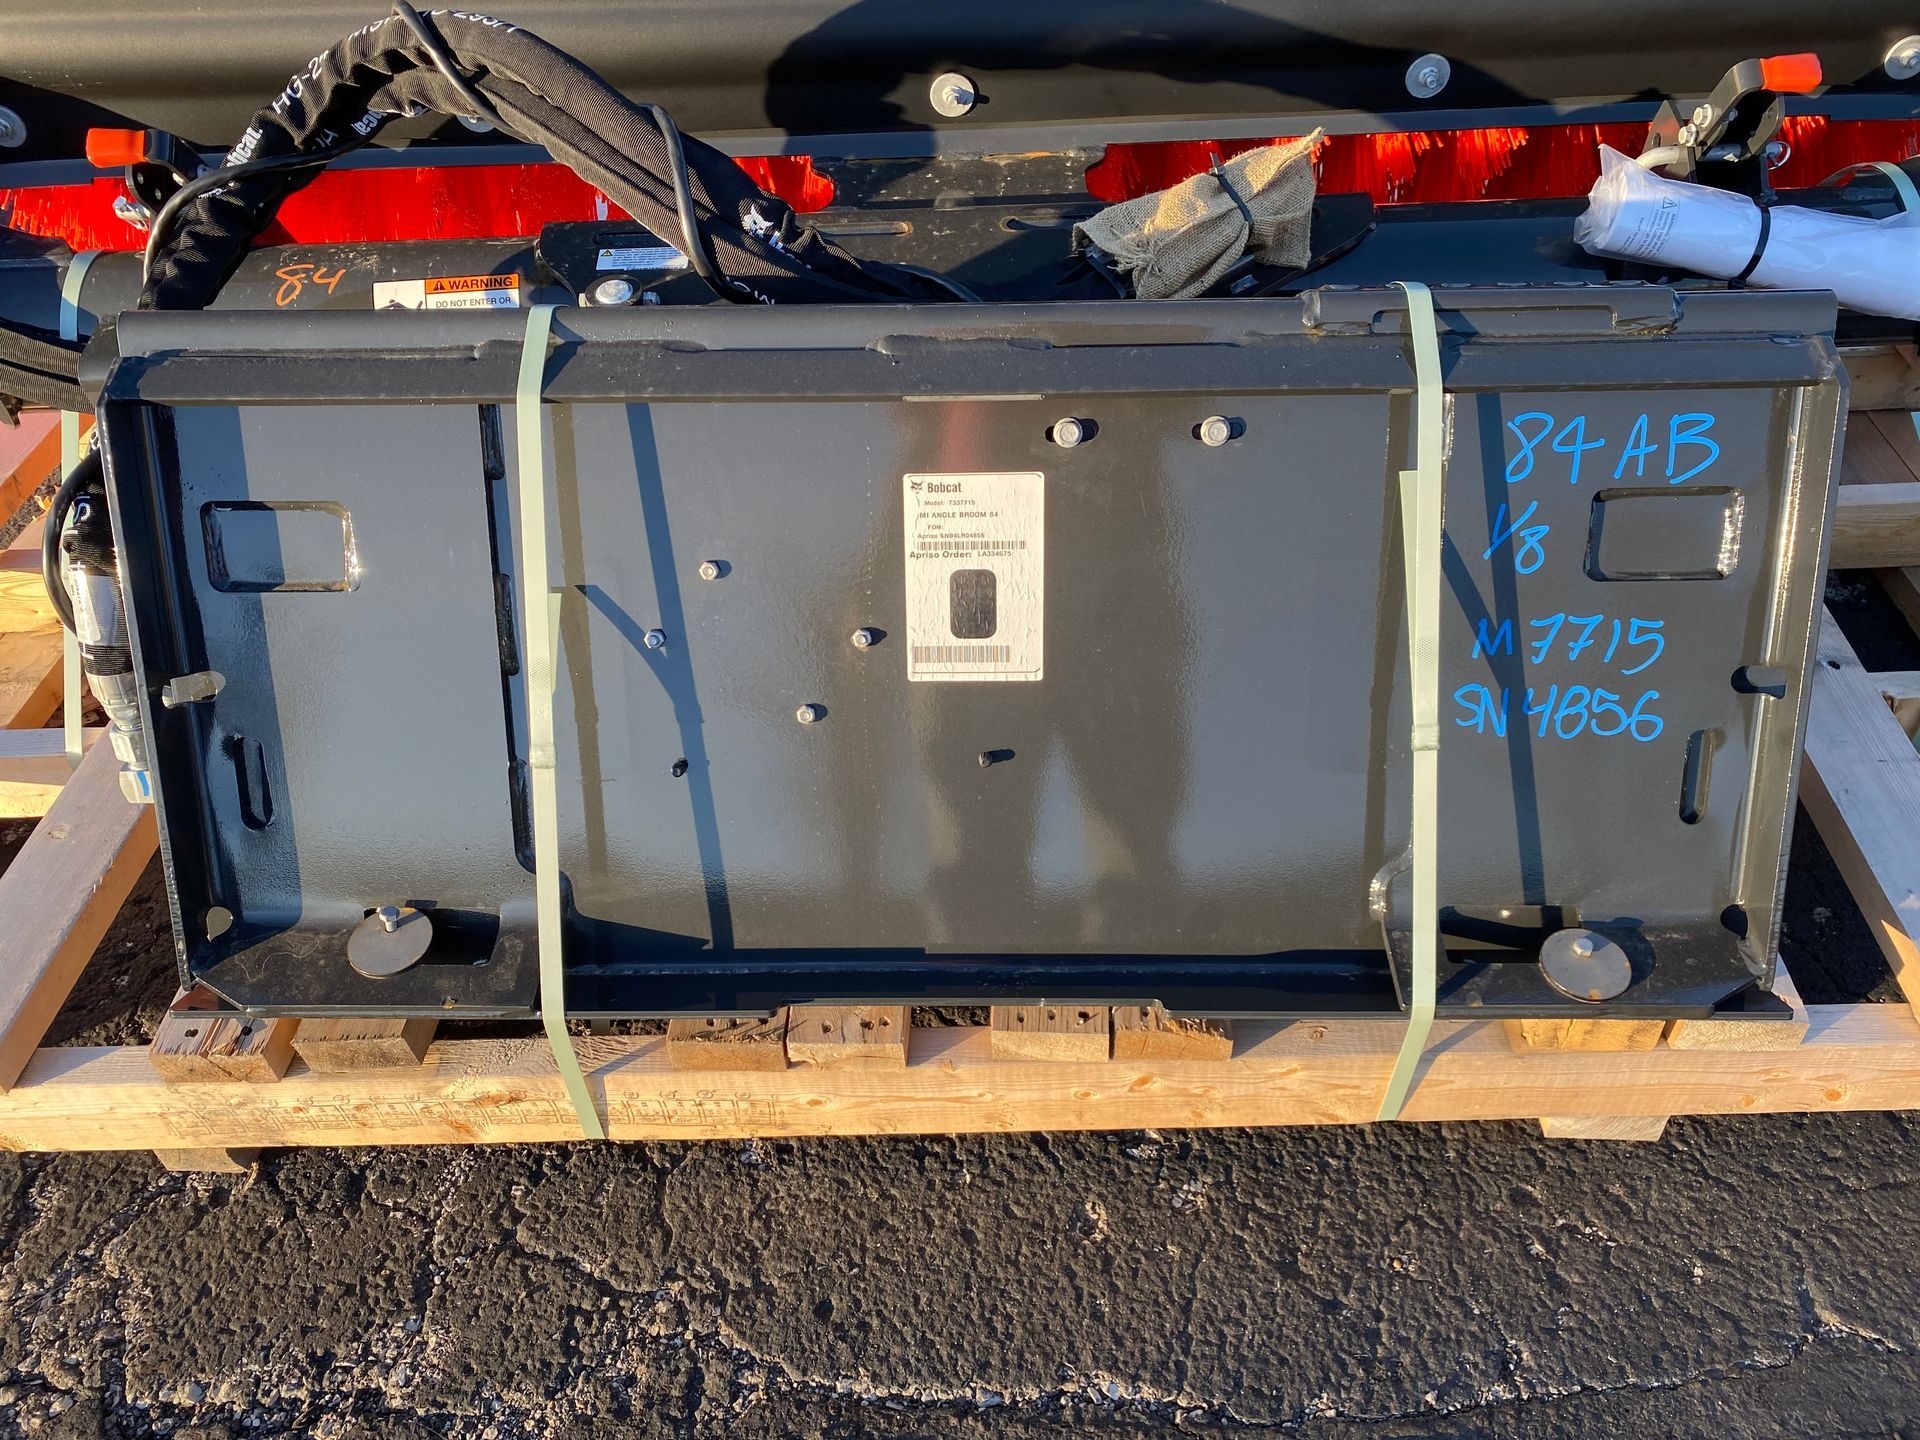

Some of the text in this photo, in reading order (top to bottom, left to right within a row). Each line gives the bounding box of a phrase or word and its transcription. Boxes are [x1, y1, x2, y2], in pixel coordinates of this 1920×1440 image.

[275, 264, 346, 307] 84
[448, 277, 513, 291] WARNING
[435, 296, 512, 309] DO NOT ENTER OR
[1504, 411, 1605, 485] 84
[927, 482, 962, 493] Bobcat
[931, 511, 957, 519] ANGLE
[917, 533, 938, 541] Apriso
[909, 551, 940, 560] Apriso
[942, 550, 972, 559] Order:
[1472, 613, 1666, 676] M 7715
